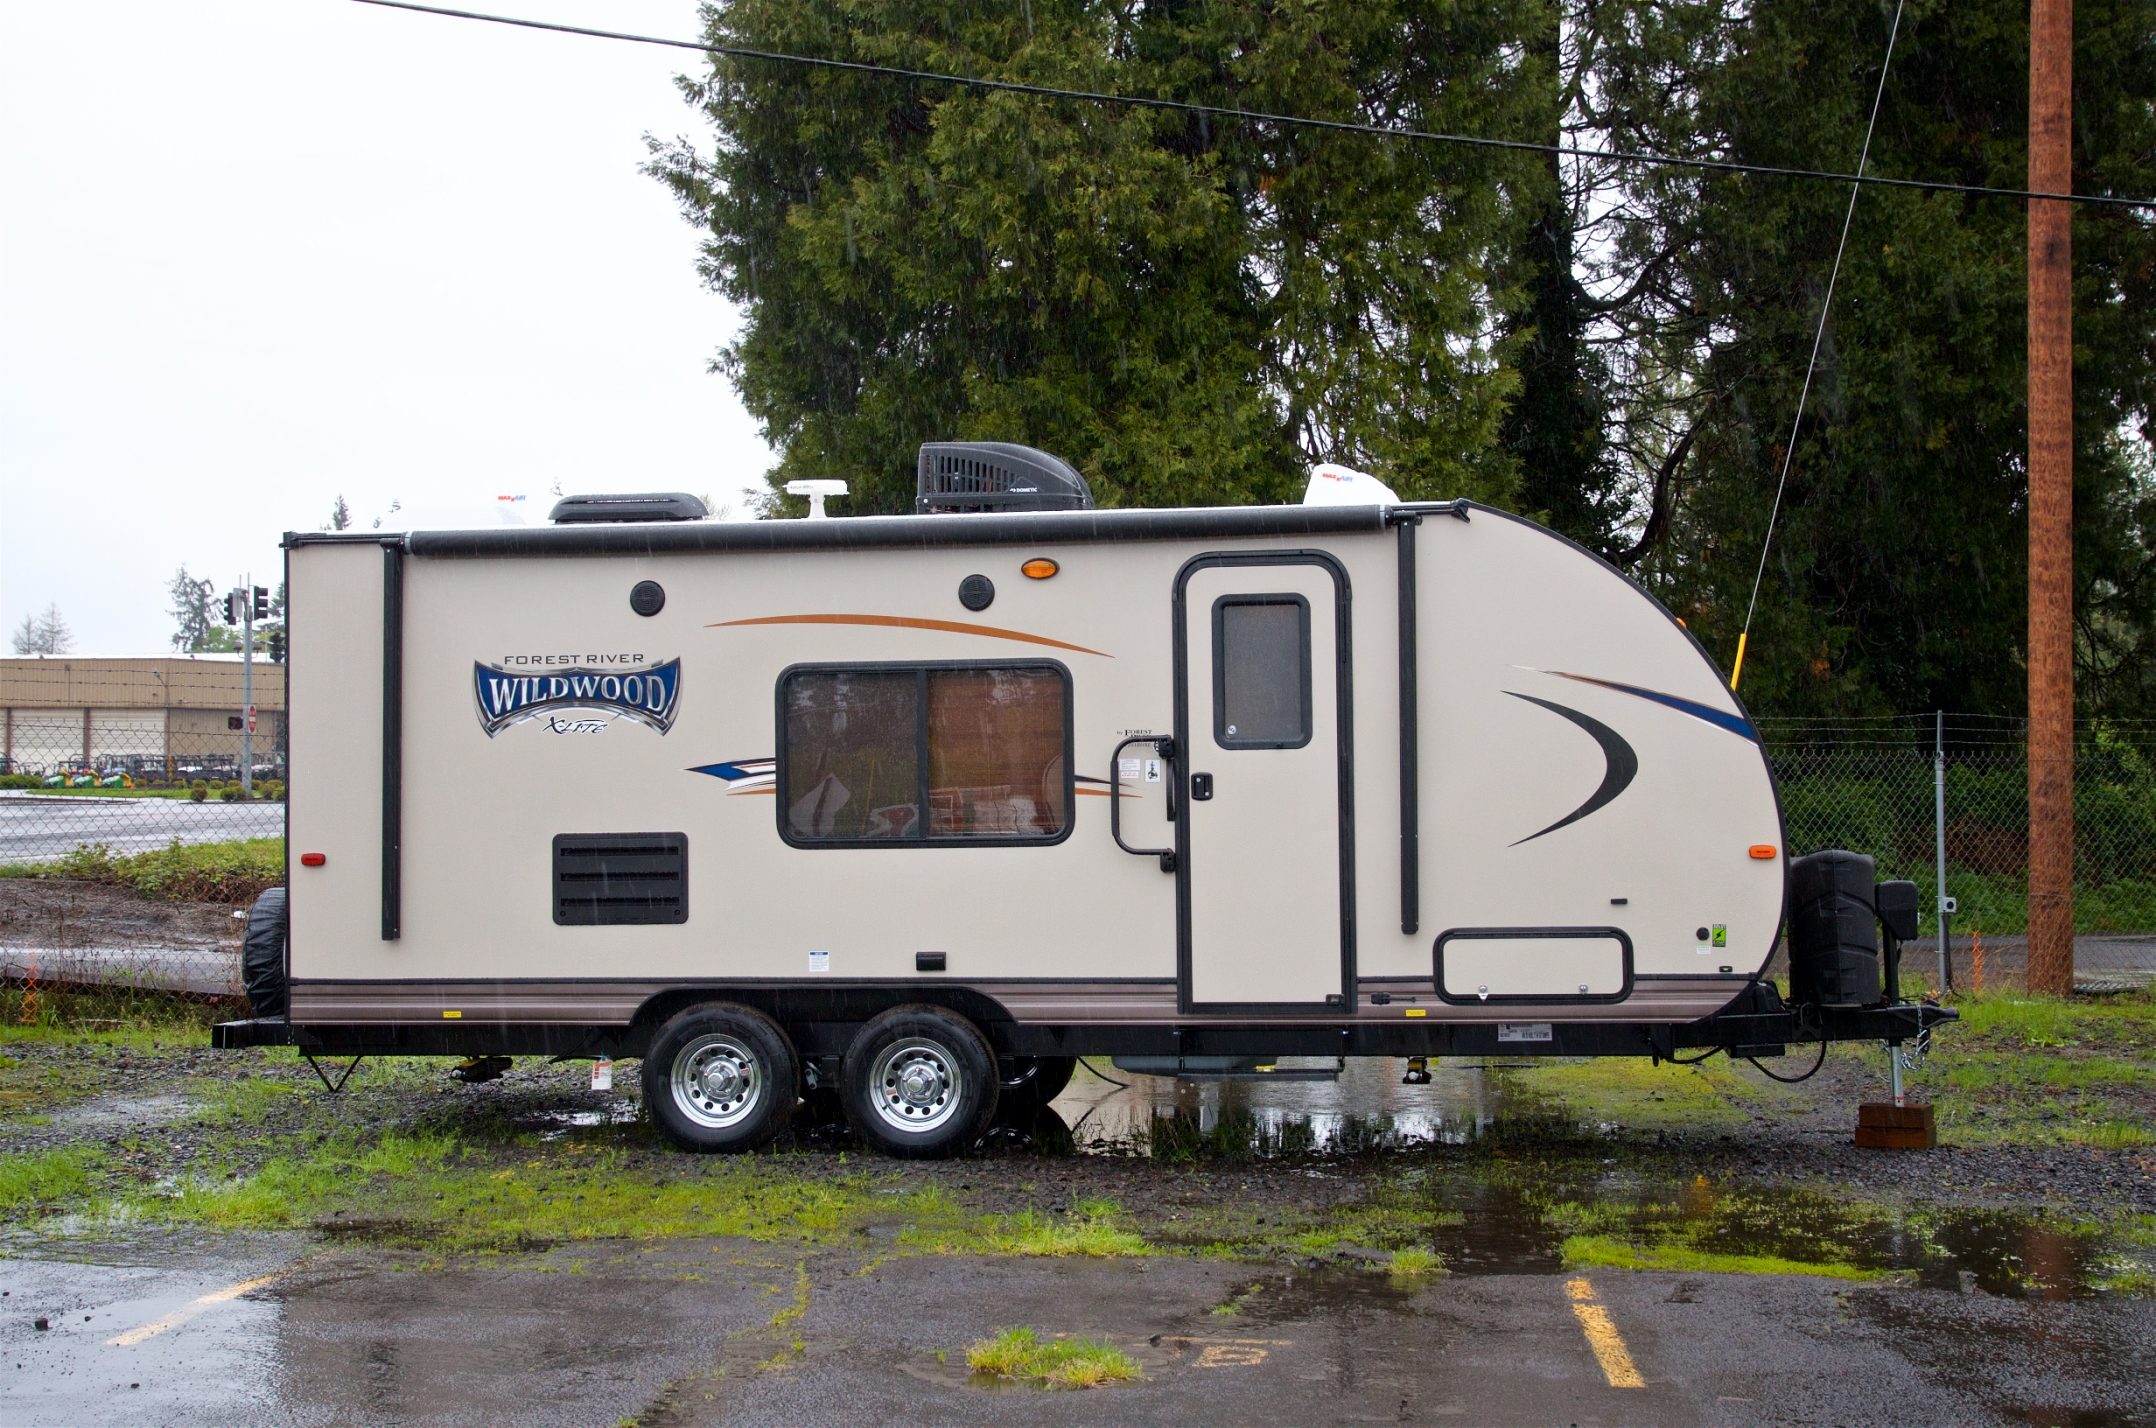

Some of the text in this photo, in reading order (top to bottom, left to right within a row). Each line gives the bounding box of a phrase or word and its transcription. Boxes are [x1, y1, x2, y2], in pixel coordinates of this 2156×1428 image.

[504, 653, 644, 665] FOREST RIVER
[489, 675, 667, 715] WILDWOOD
